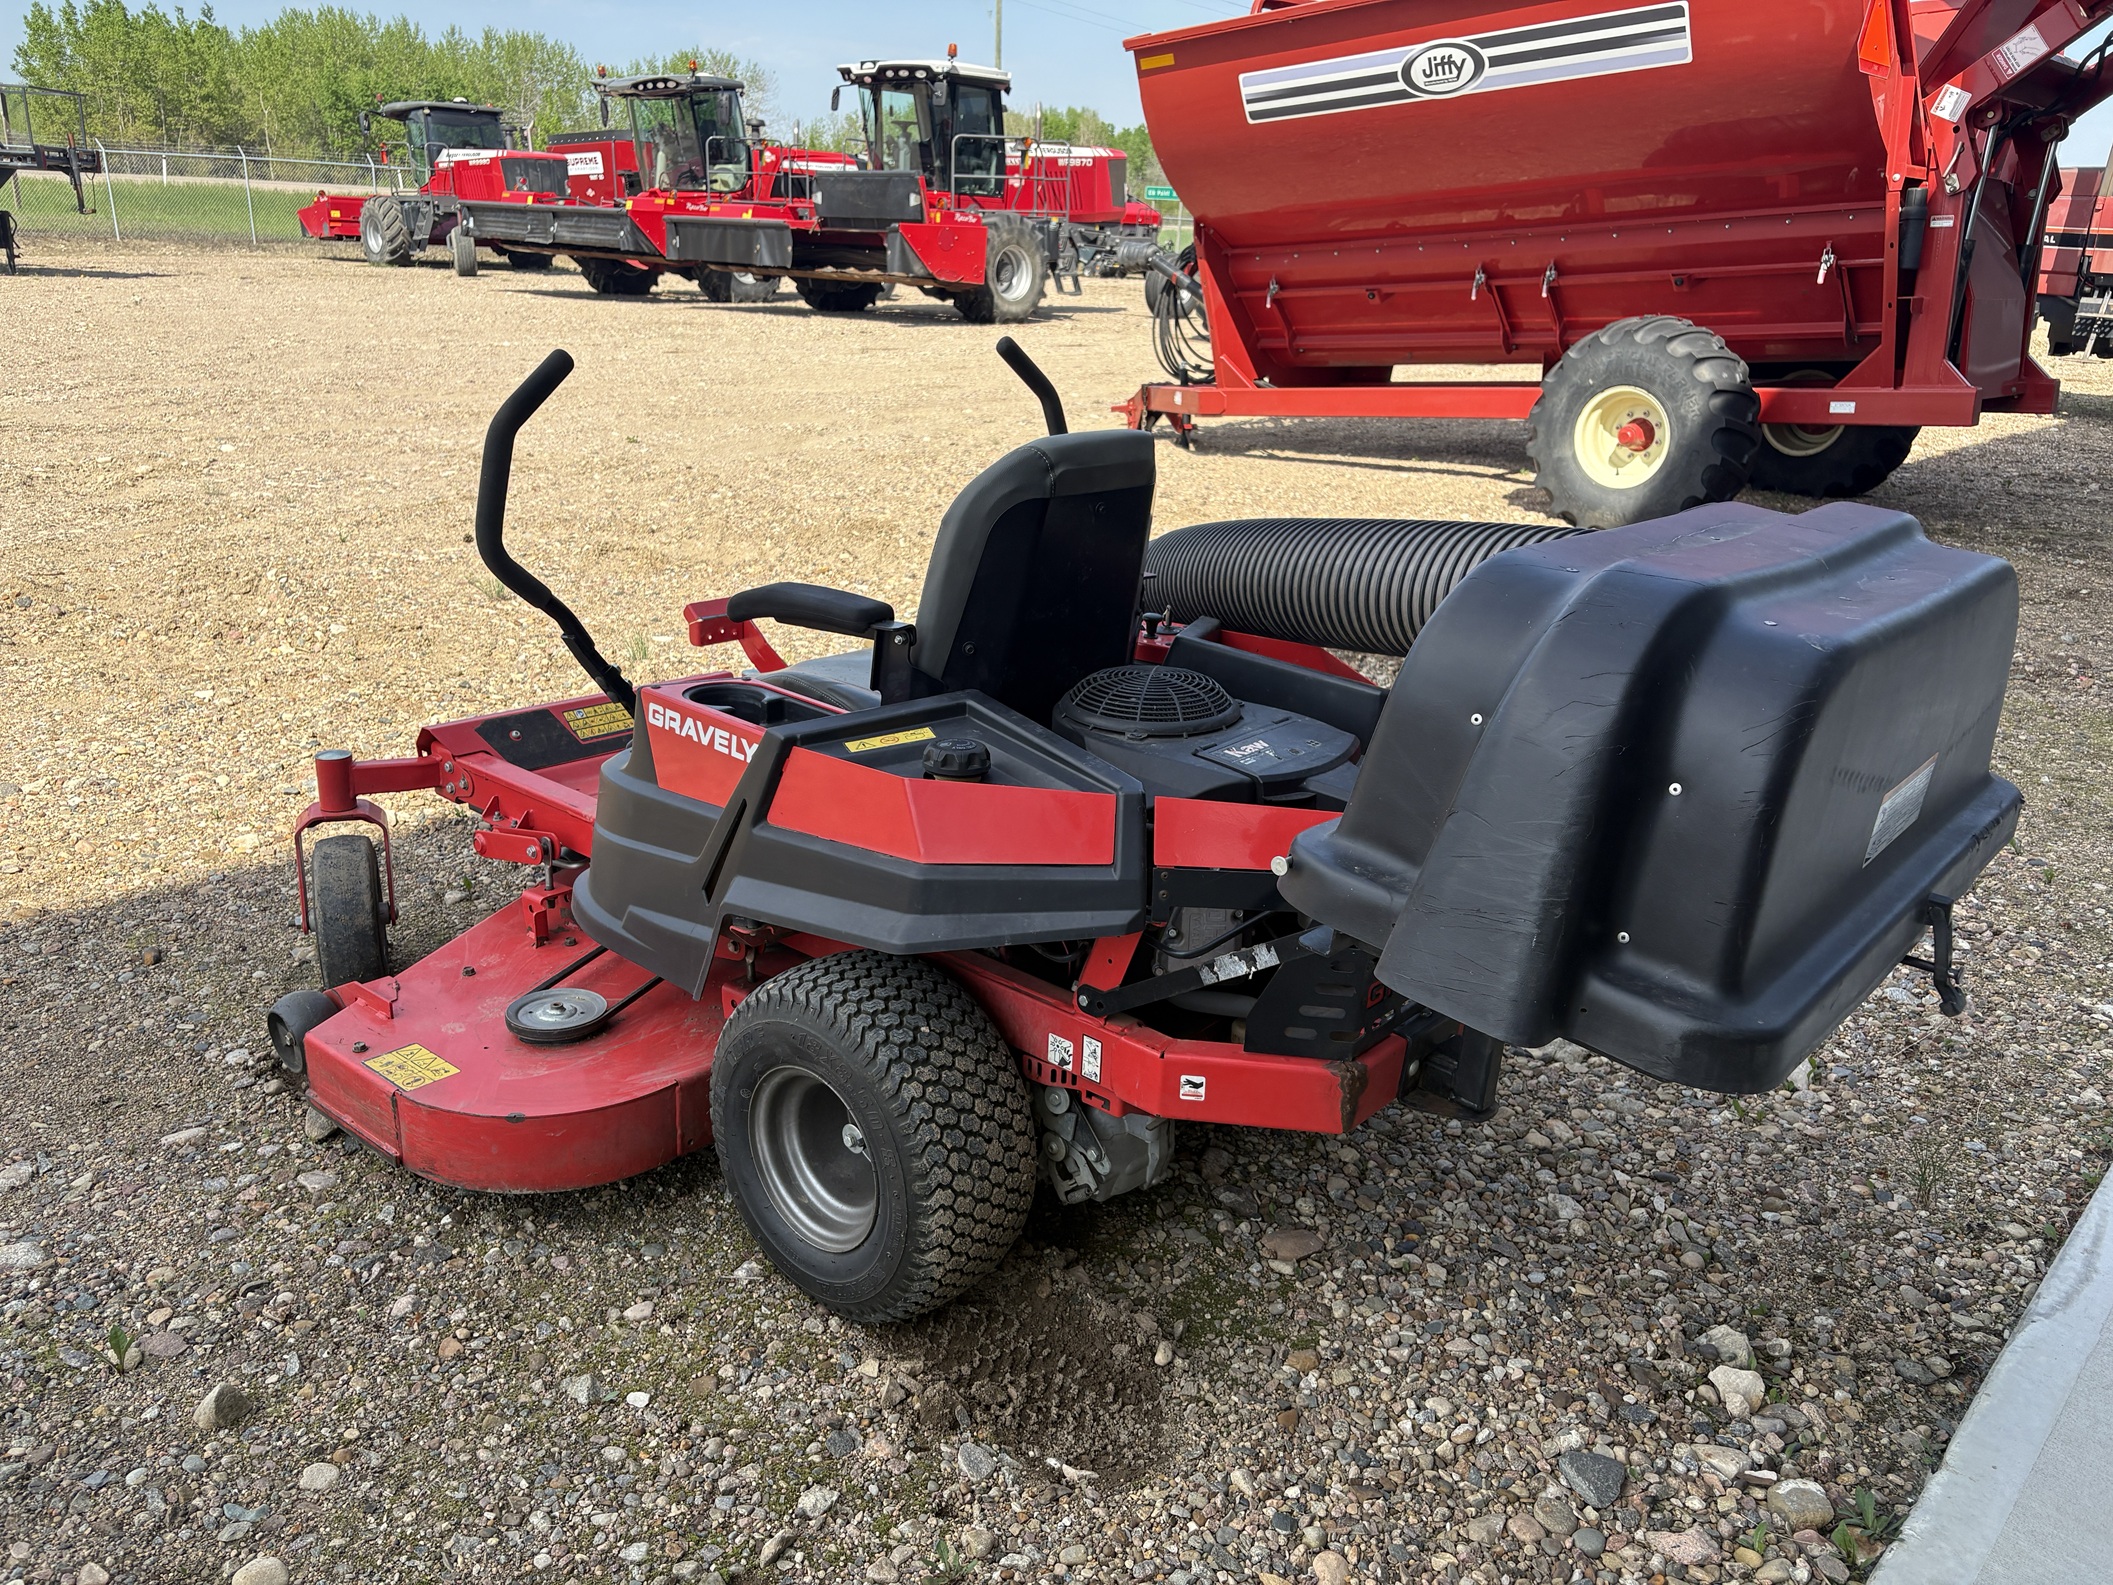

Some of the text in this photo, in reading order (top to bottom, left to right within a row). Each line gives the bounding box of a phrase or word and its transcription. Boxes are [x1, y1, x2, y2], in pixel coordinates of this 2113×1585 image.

[1422, 54, 1467, 81] Jiffy
[1996, 53, 2009, 70] DANGER
[648, 702, 759, 764] GRAVELY
